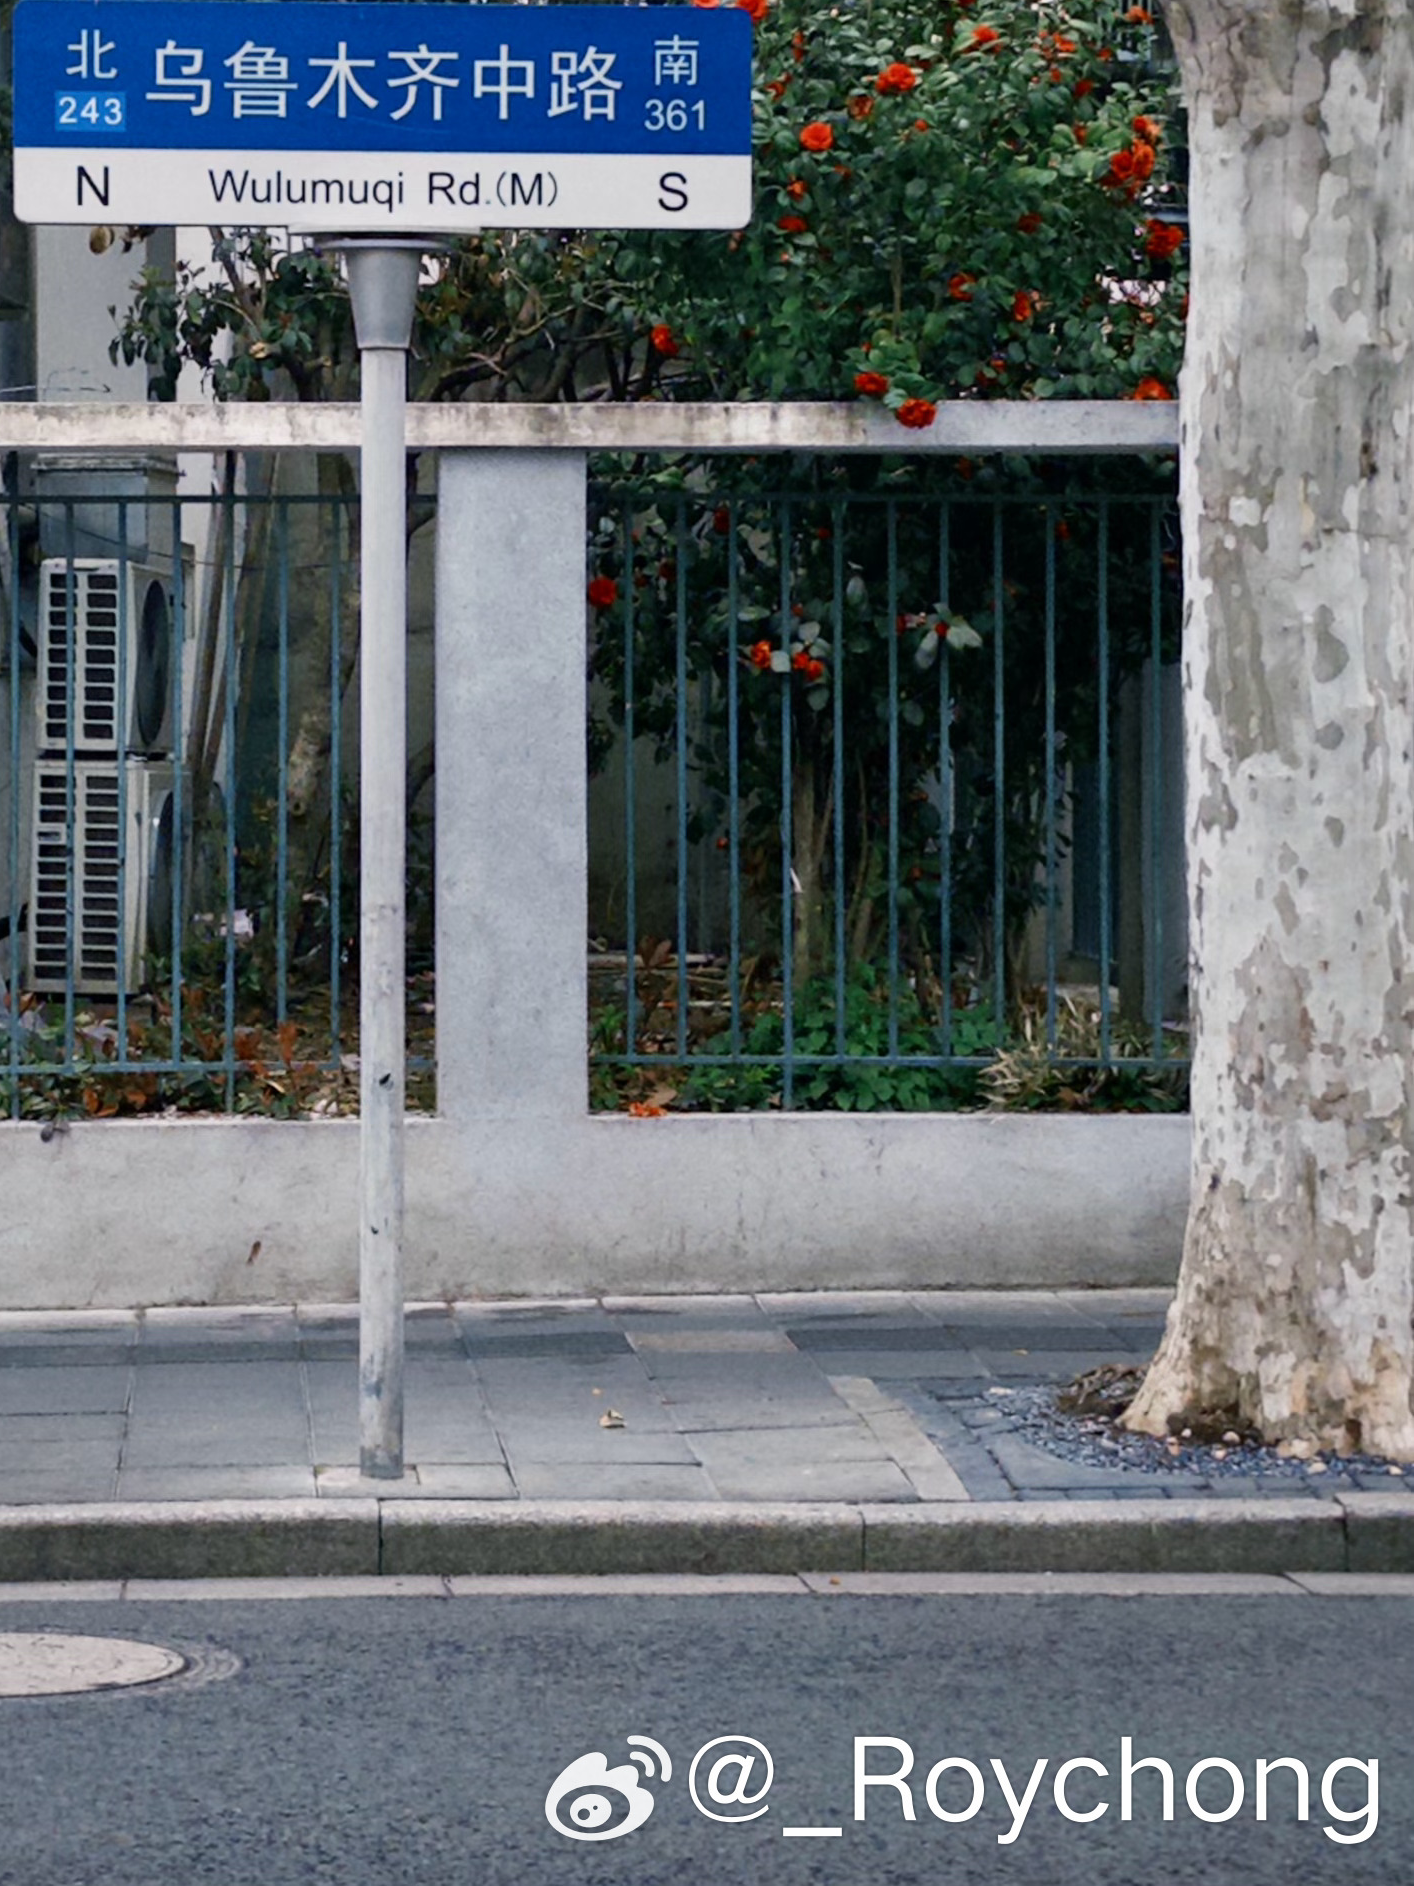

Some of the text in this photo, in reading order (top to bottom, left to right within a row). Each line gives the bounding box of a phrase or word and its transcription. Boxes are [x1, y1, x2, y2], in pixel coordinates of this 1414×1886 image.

[65, 29, 699, 121] 北 乌鲁木齐中路 南
[58, 96, 123, 125] 243
[644, 99, 705, 131] 361
[77, 166, 109, 206] N
[208, 169, 404, 213] Wulumuqi
[658, 172, 689, 212] S
